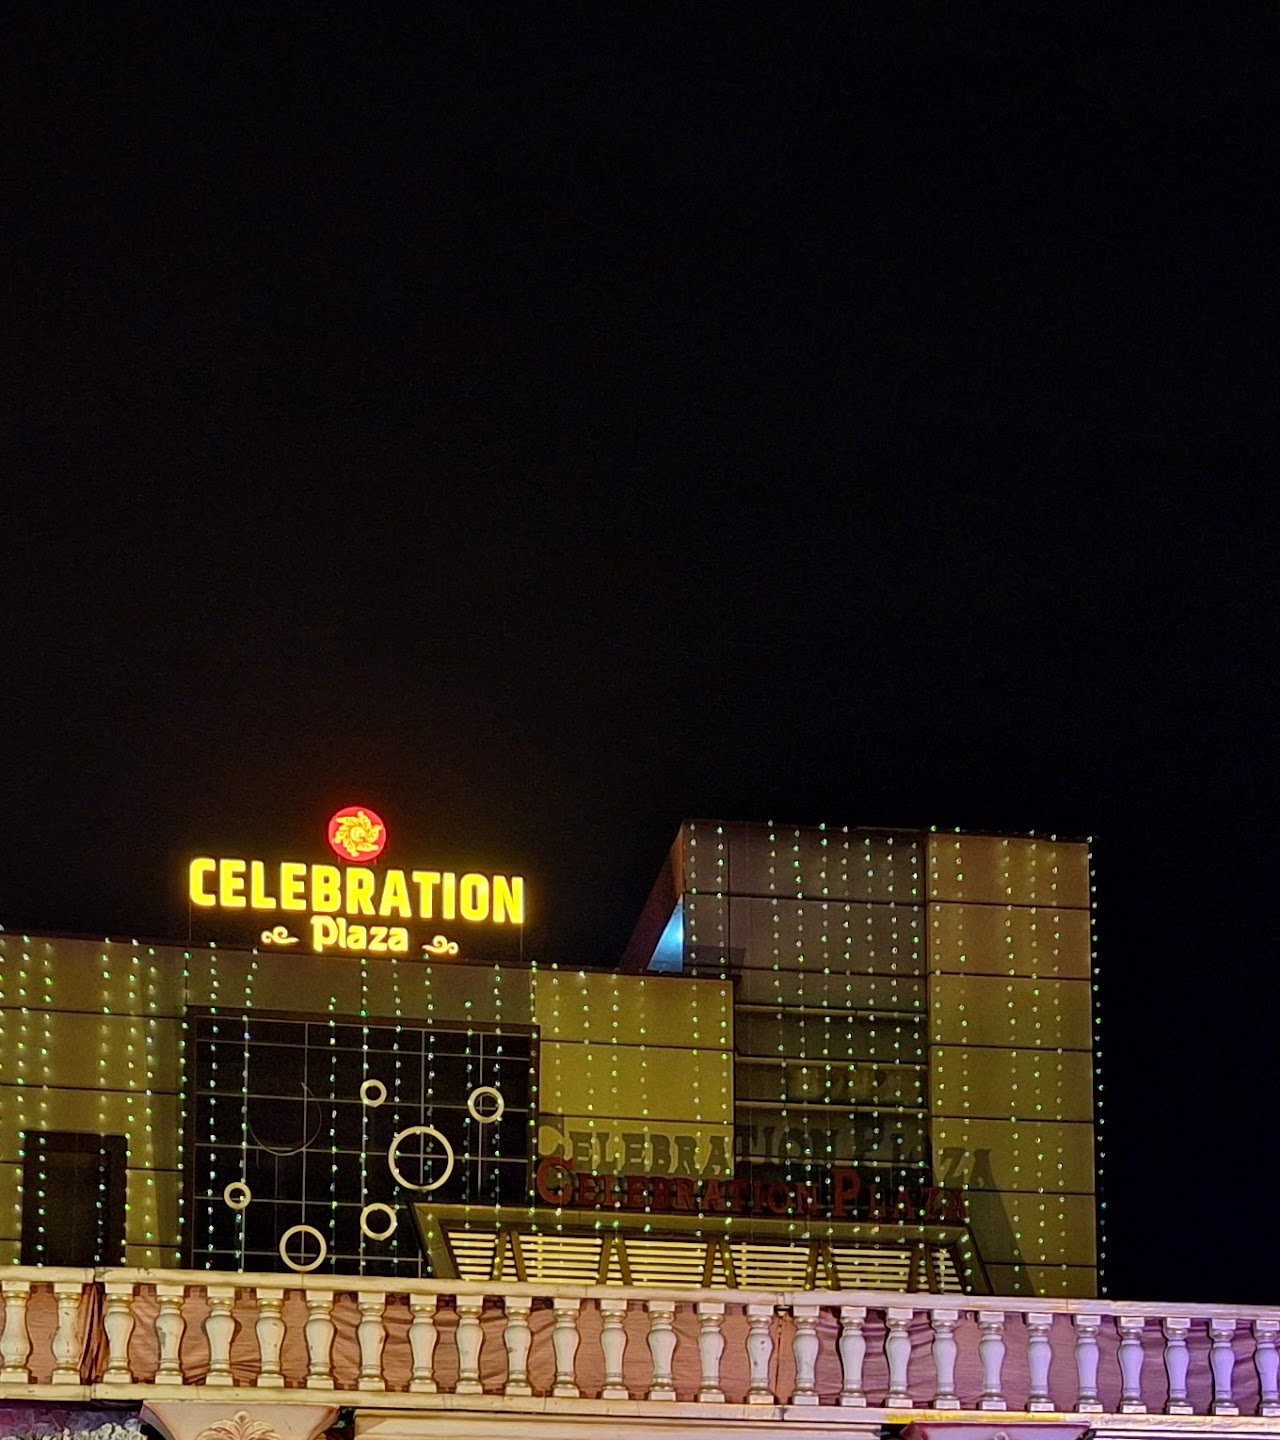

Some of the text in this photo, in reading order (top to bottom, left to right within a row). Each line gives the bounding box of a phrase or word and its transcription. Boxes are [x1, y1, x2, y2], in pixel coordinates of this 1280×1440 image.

[189, 856, 526, 925] CELEBRATION
[310, 914, 410, 953] Plaza
[536, 1156, 970, 1221] CELEBRATION PLAZA
